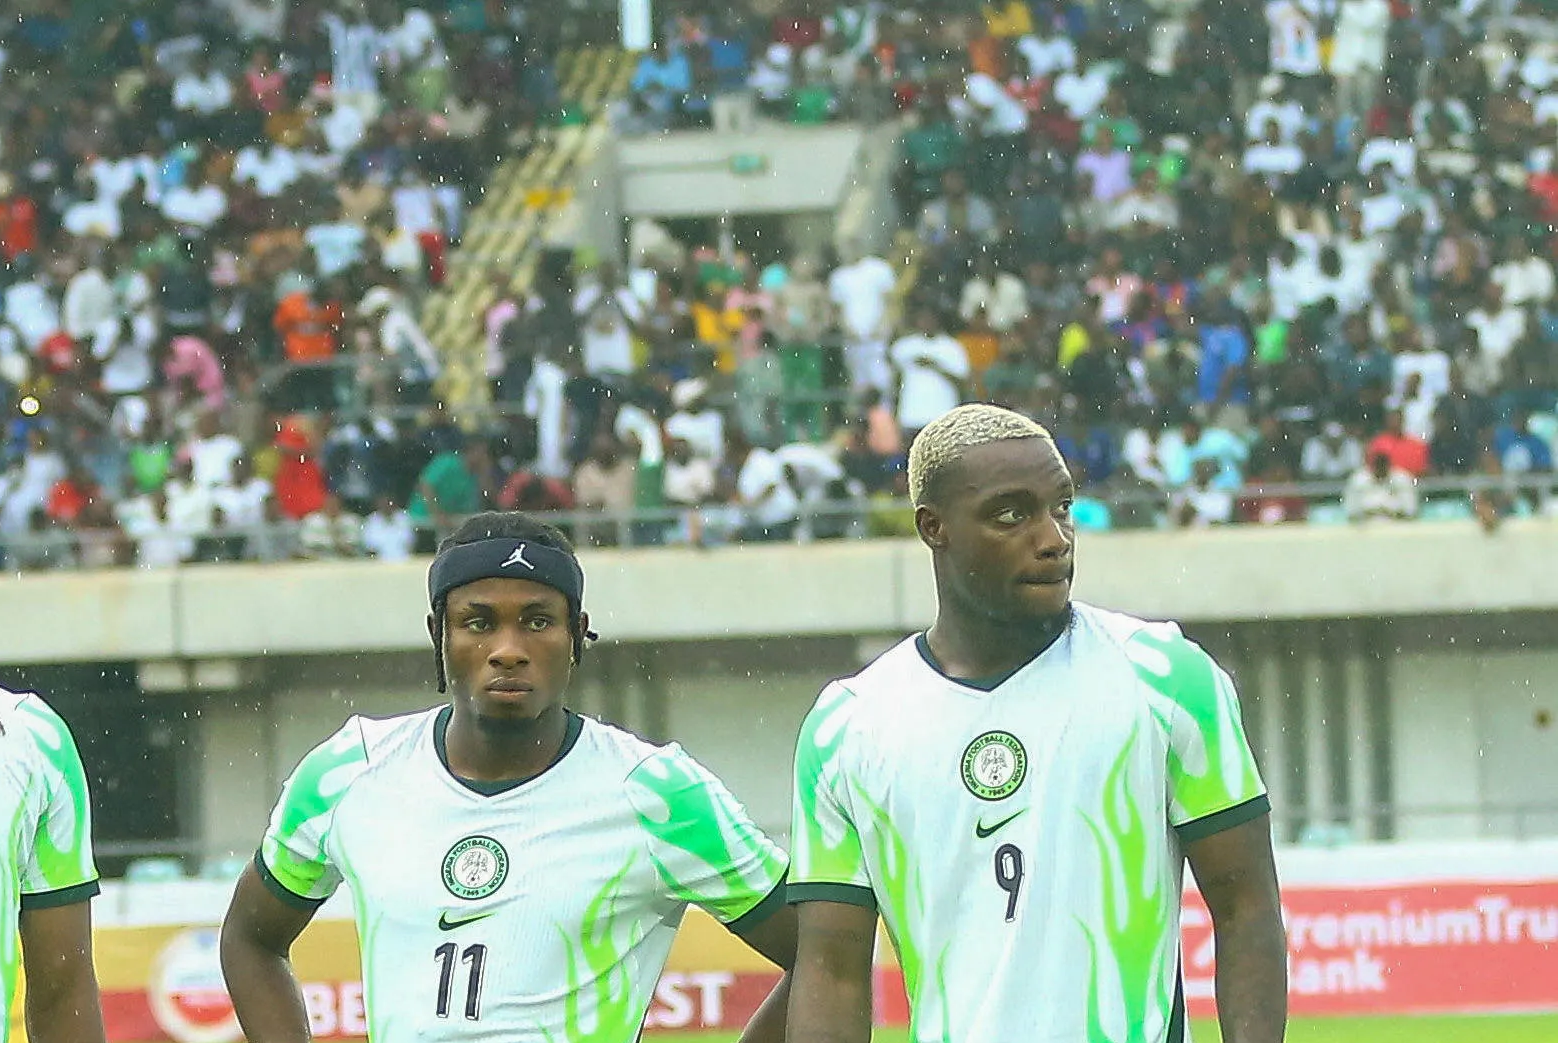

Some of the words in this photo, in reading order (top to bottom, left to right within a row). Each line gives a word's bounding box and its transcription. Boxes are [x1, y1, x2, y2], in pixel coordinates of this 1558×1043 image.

[994, 843, 1026, 923] 9
[1281, 893, 1558, 950] remiumTru
[434, 942, 487, 1021] 11
[645, 971, 735, 1027] ST
[1287, 947, 1386, 994] ank
